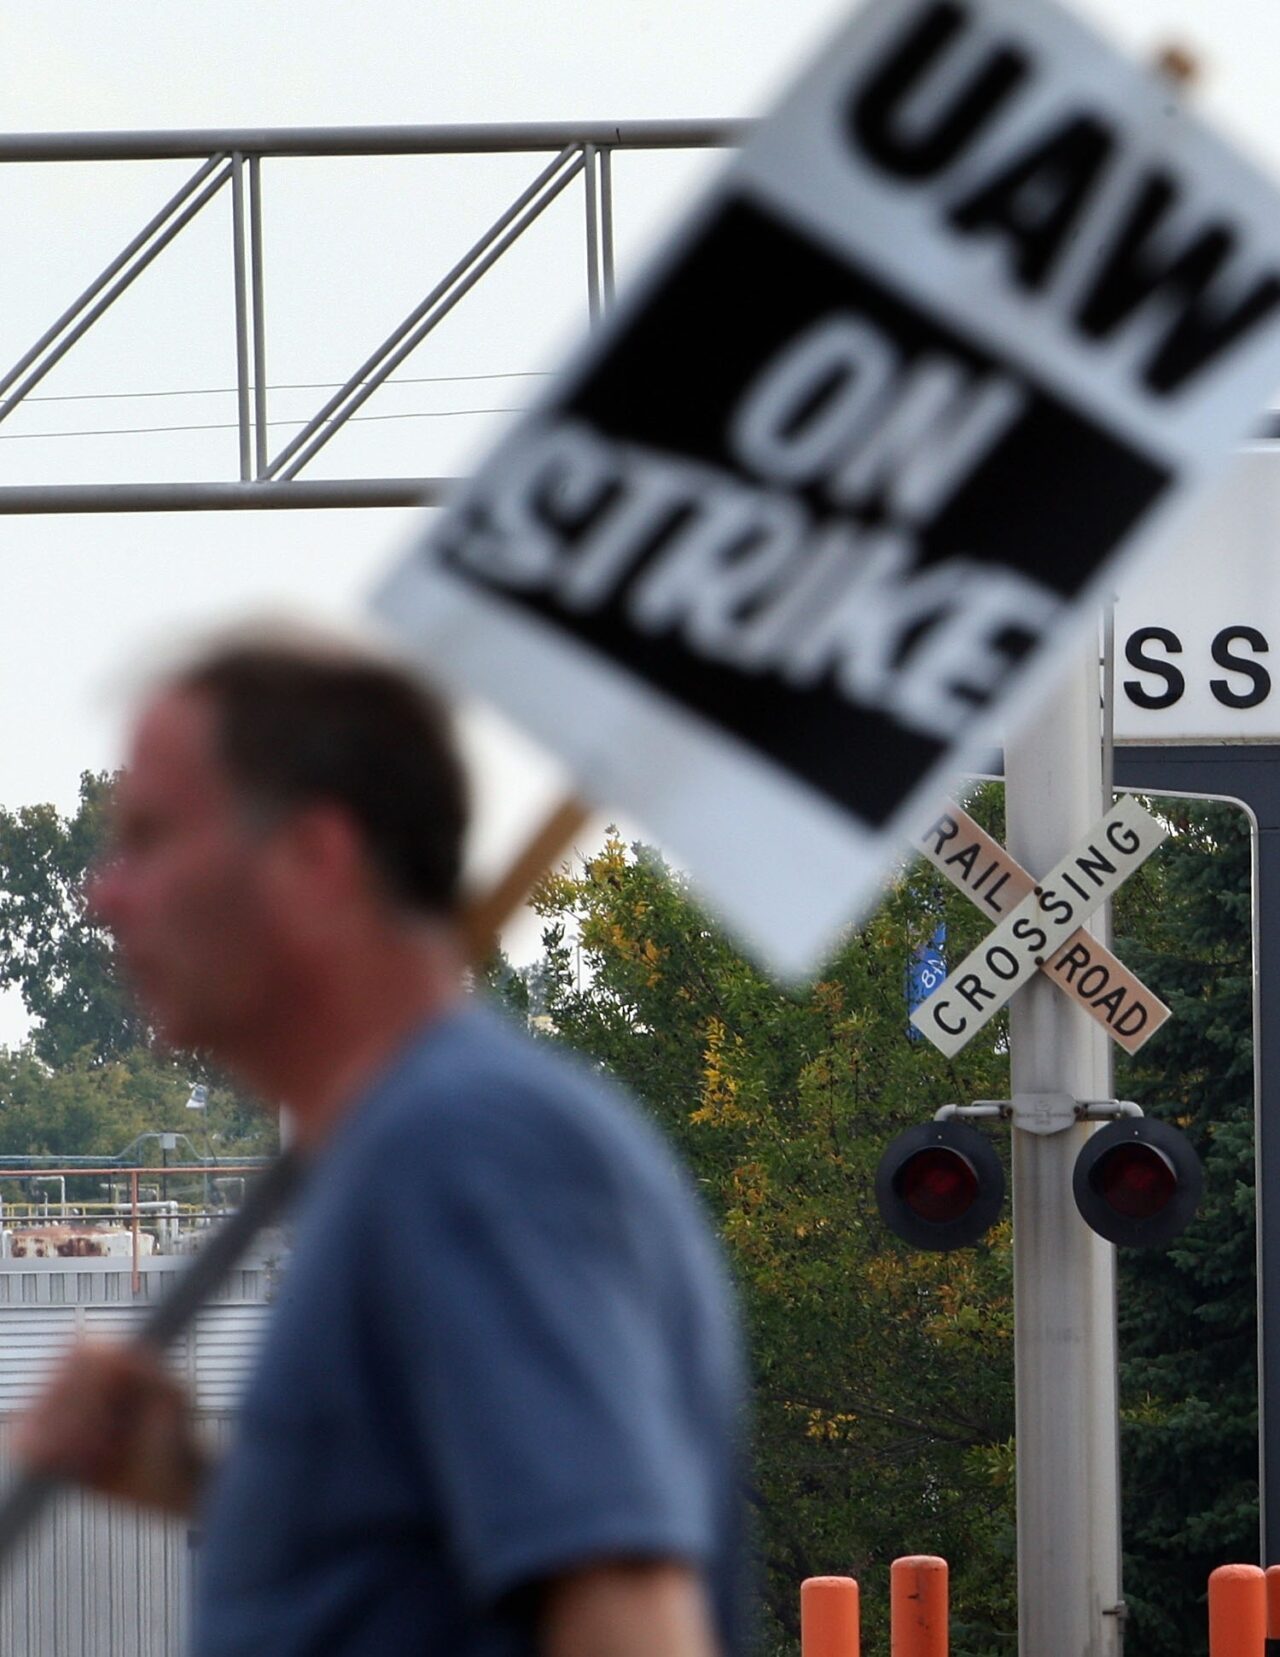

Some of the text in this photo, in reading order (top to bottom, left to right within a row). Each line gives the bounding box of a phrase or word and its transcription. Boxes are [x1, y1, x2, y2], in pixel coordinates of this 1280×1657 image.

[730, 308, 1024, 512] ON
[442, 418, 1066, 738] STRIKE
[922, 813, 1148, 1037] RAIL ROAD
[933, 821, 1141, 1036] CROSSING
